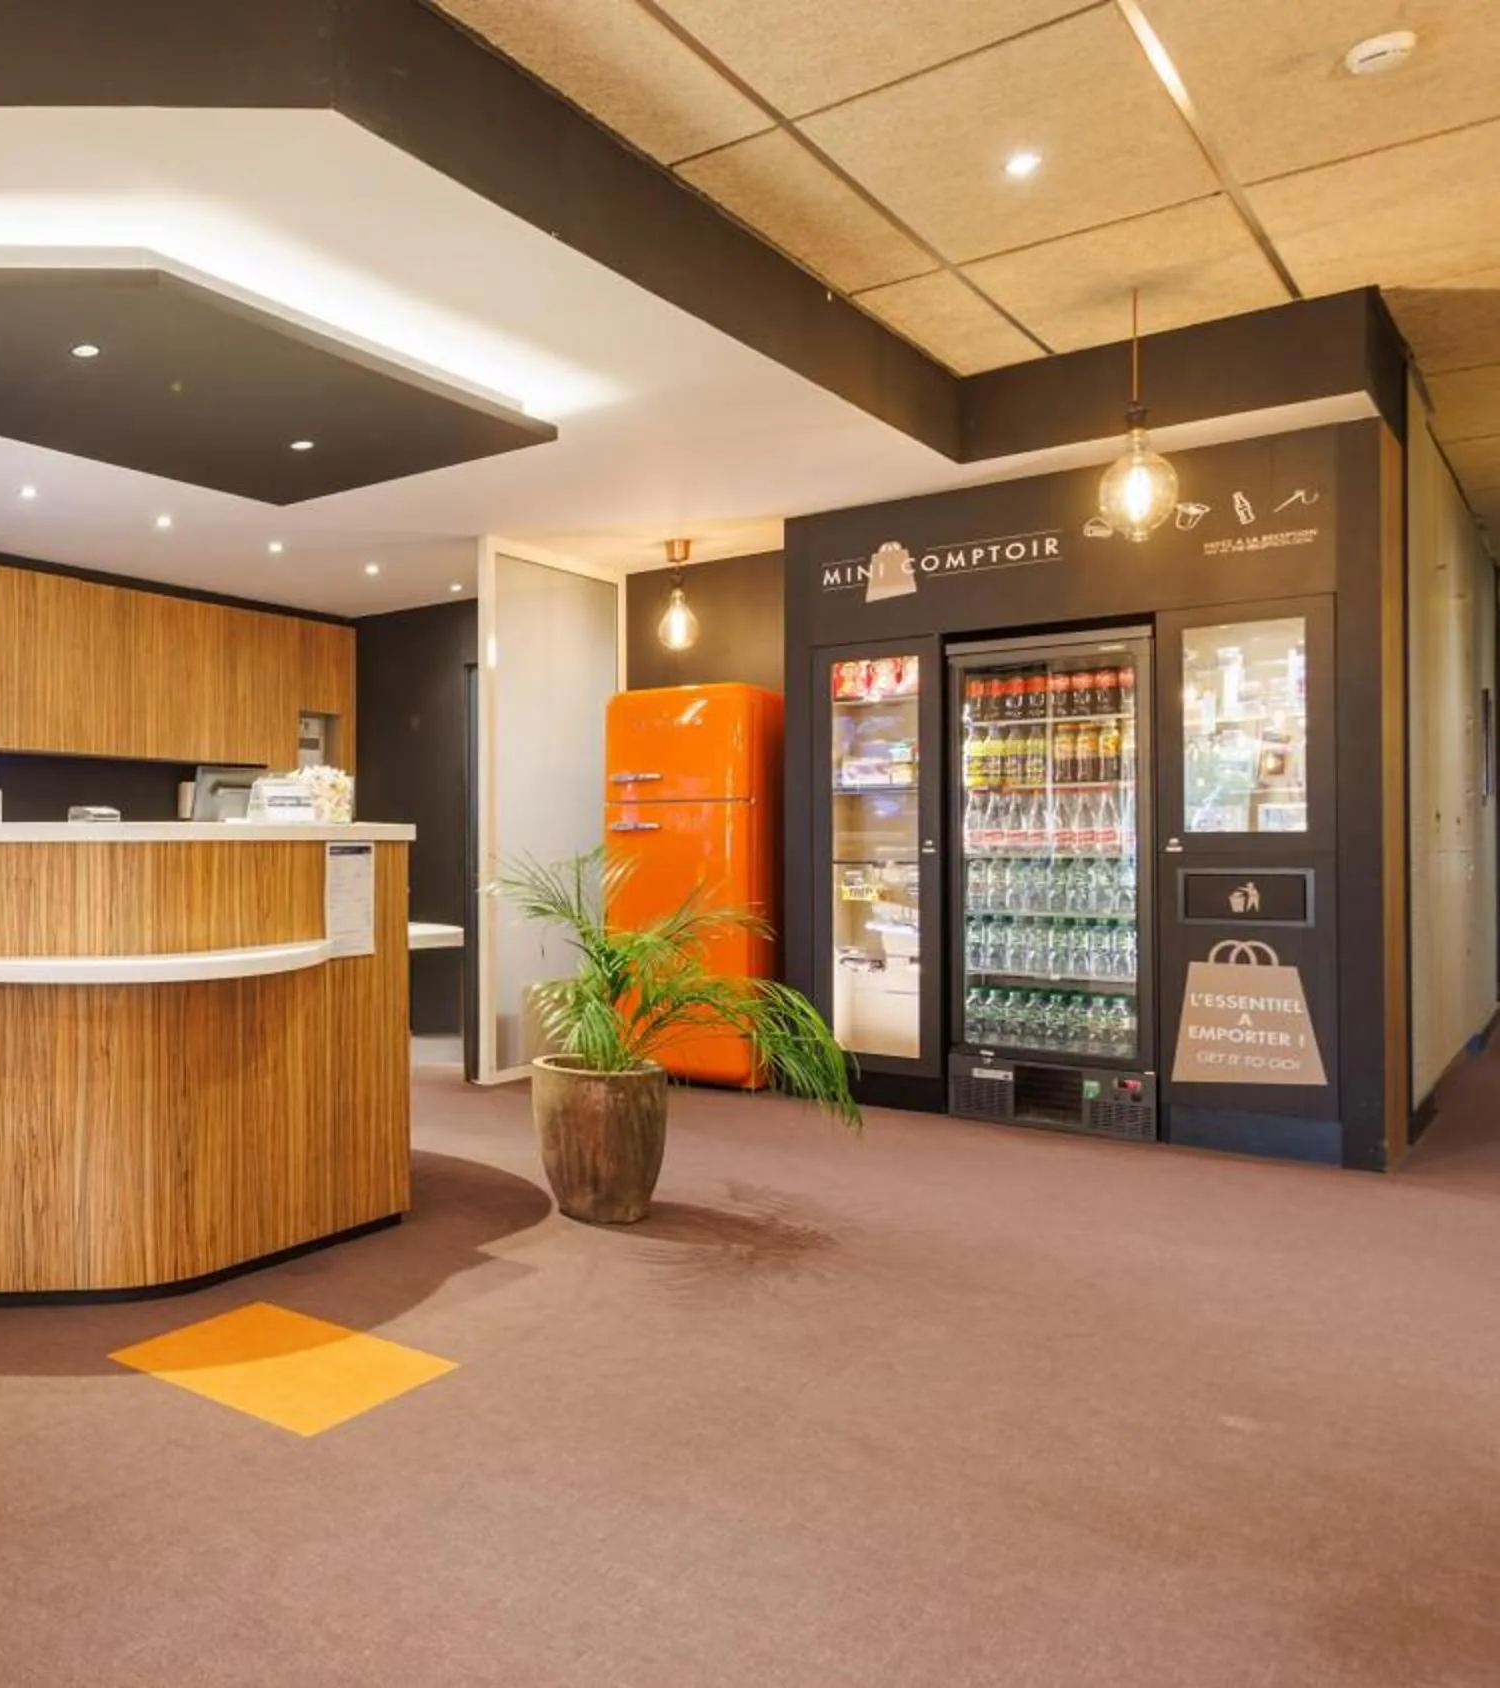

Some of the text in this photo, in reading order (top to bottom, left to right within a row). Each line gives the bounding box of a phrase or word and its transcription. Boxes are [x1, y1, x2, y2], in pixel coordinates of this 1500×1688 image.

[822, 537, 1059, 586] MINI COMPTOIR
[1190, 992, 1304, 1013] L'ESSENTIEL
[1237, 1013, 1253, 1027] A
[1188, 1025, 1291, 1047] EMPORTER
[1196, 1049, 1223, 1065] GET
[1228, 1053, 1239, 1066] IT
[1245, 1055, 1265, 1068] TO
